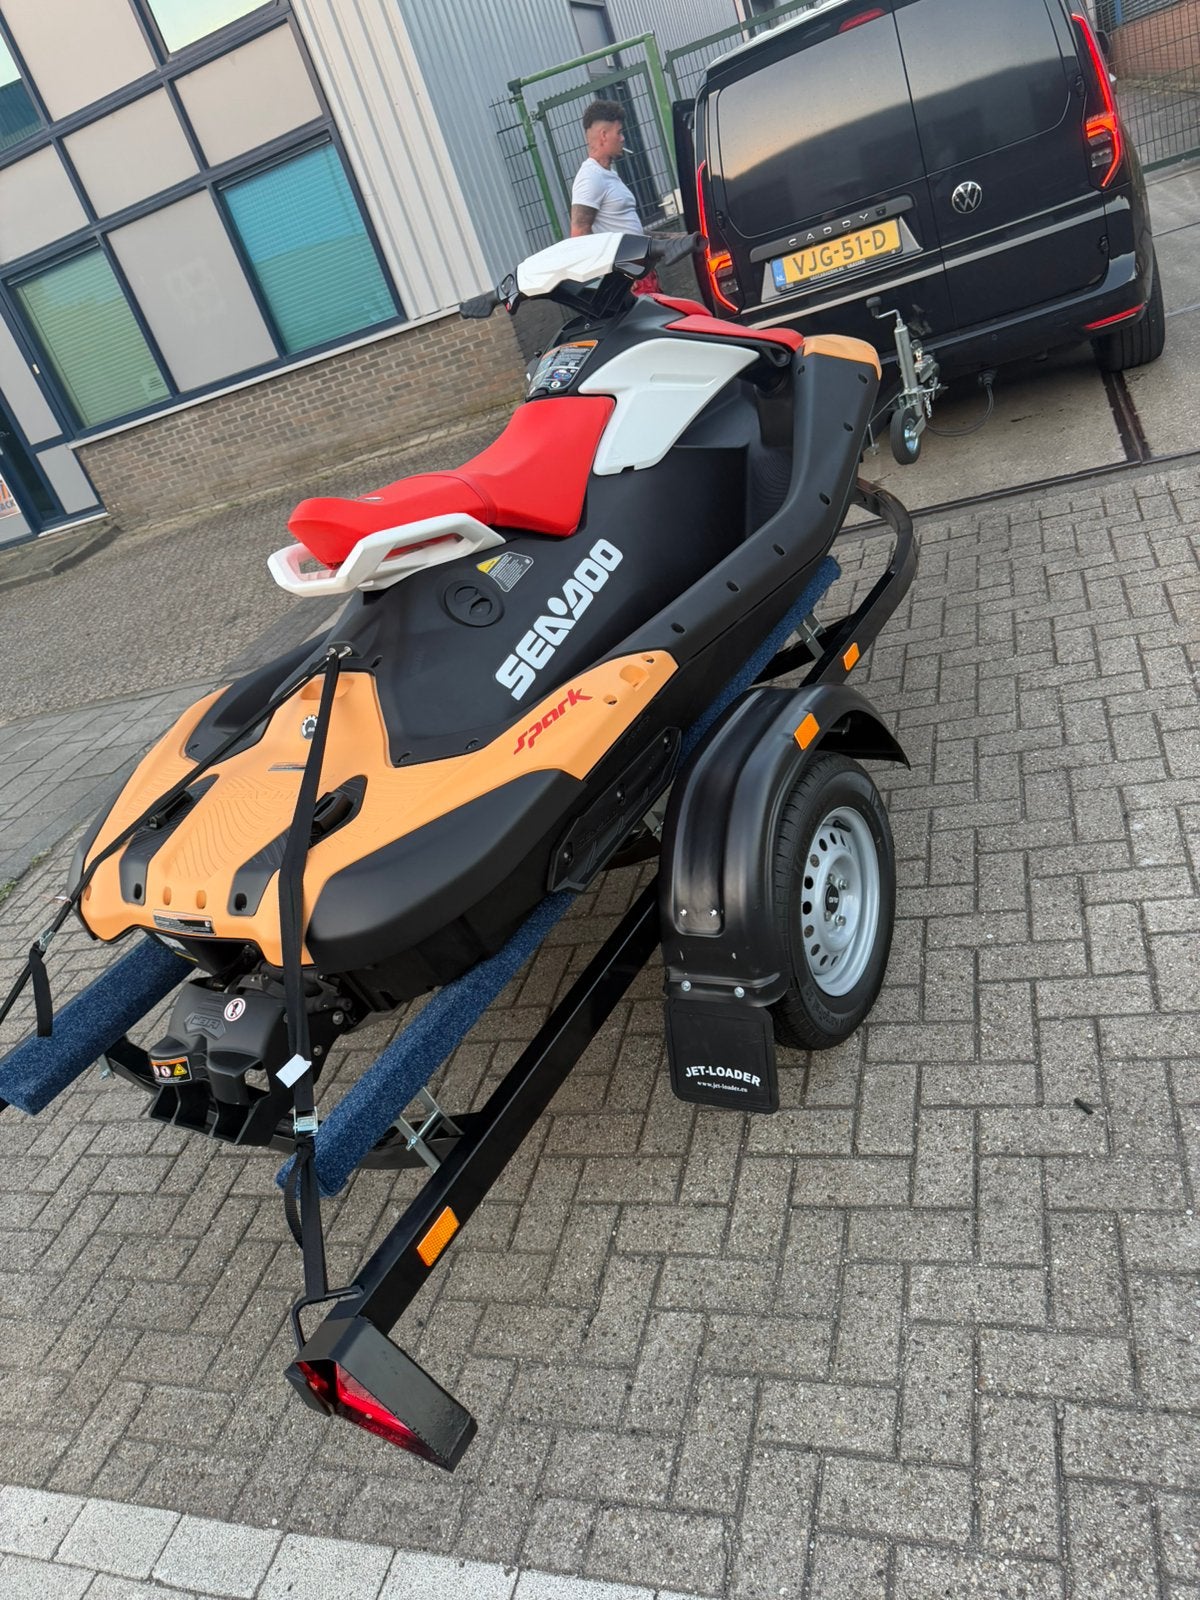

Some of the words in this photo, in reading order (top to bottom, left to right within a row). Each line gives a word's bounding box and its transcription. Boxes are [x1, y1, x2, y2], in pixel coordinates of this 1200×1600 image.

[788, 213, 869, 247] CADDY
[793, 229, 886, 275] VJG-51-D
[685, 1065, 761, 1087] JET-LOADER
